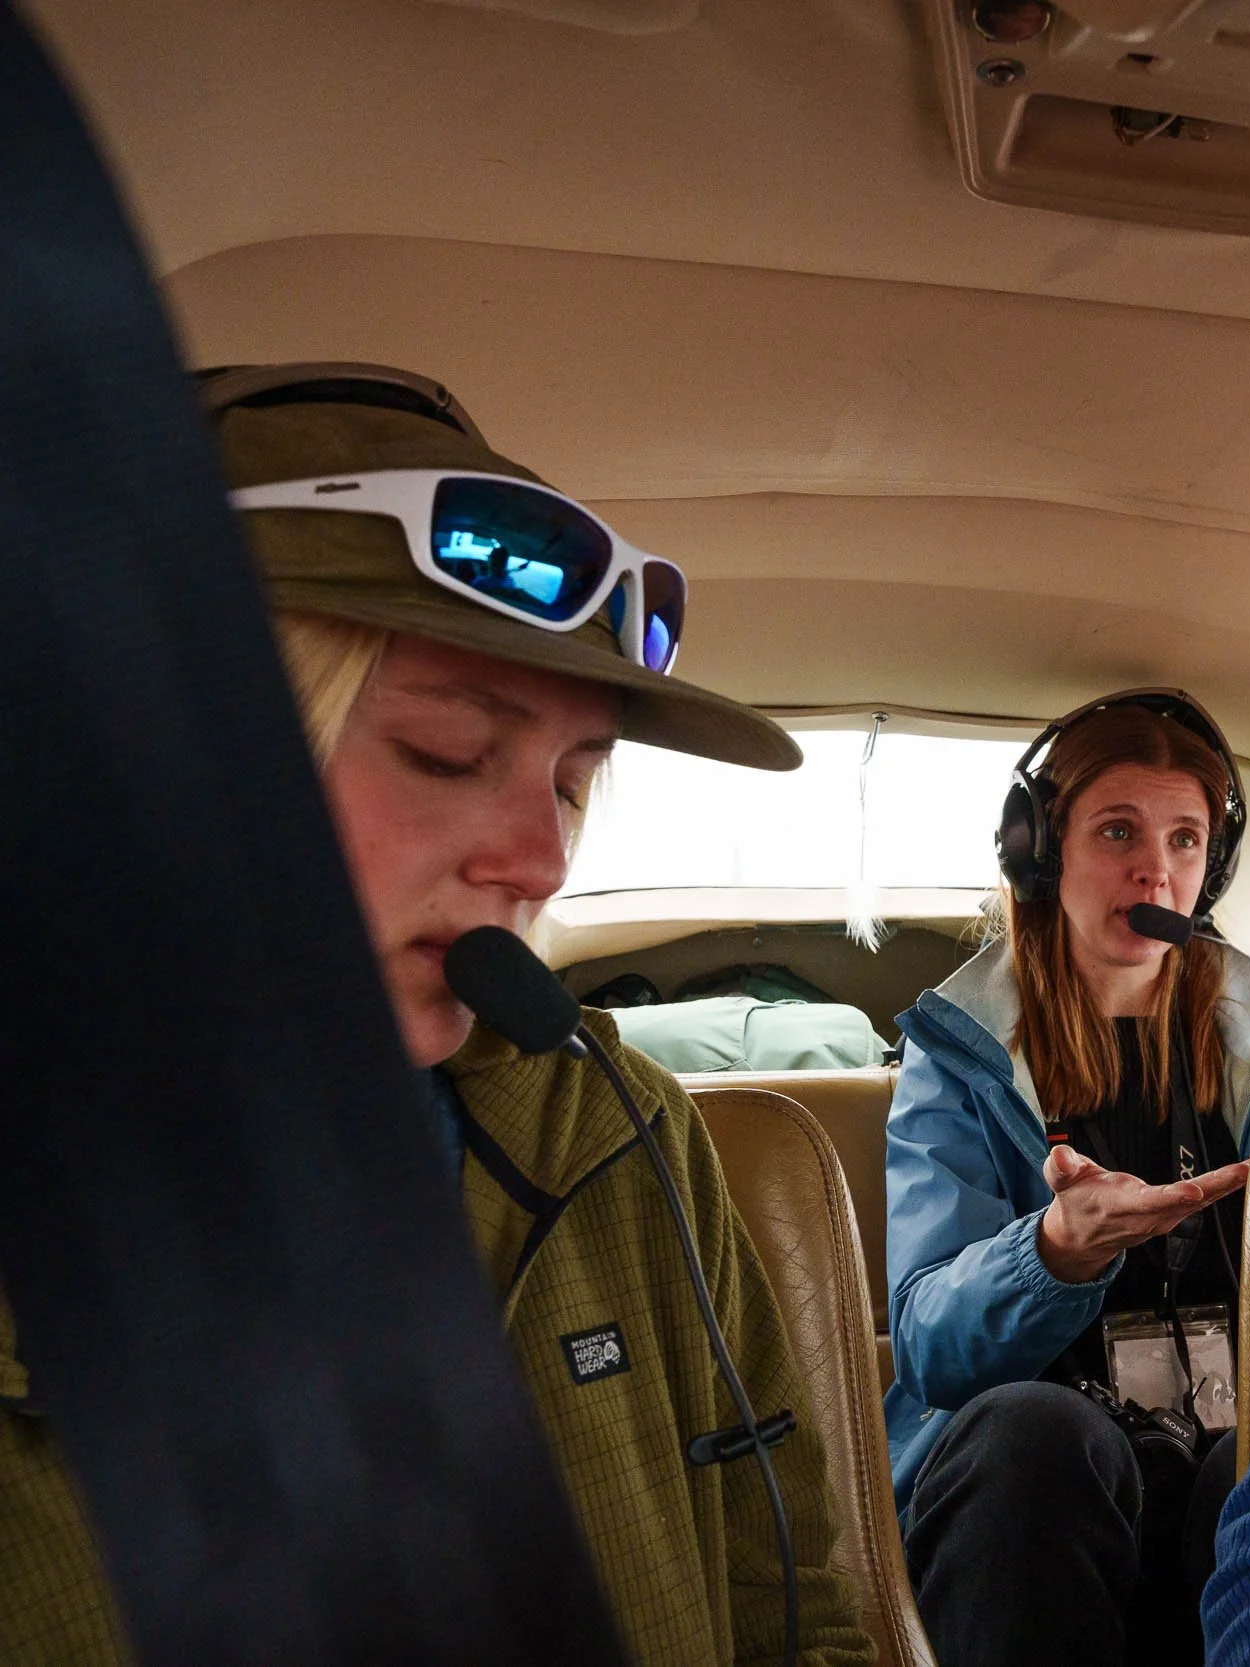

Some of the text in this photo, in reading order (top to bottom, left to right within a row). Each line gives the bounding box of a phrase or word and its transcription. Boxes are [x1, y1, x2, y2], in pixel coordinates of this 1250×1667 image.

[574, 1344, 603, 1363] HARD
[578, 1356, 607, 1376] WEAR
[1162, 1416, 1190, 1438] SONY
